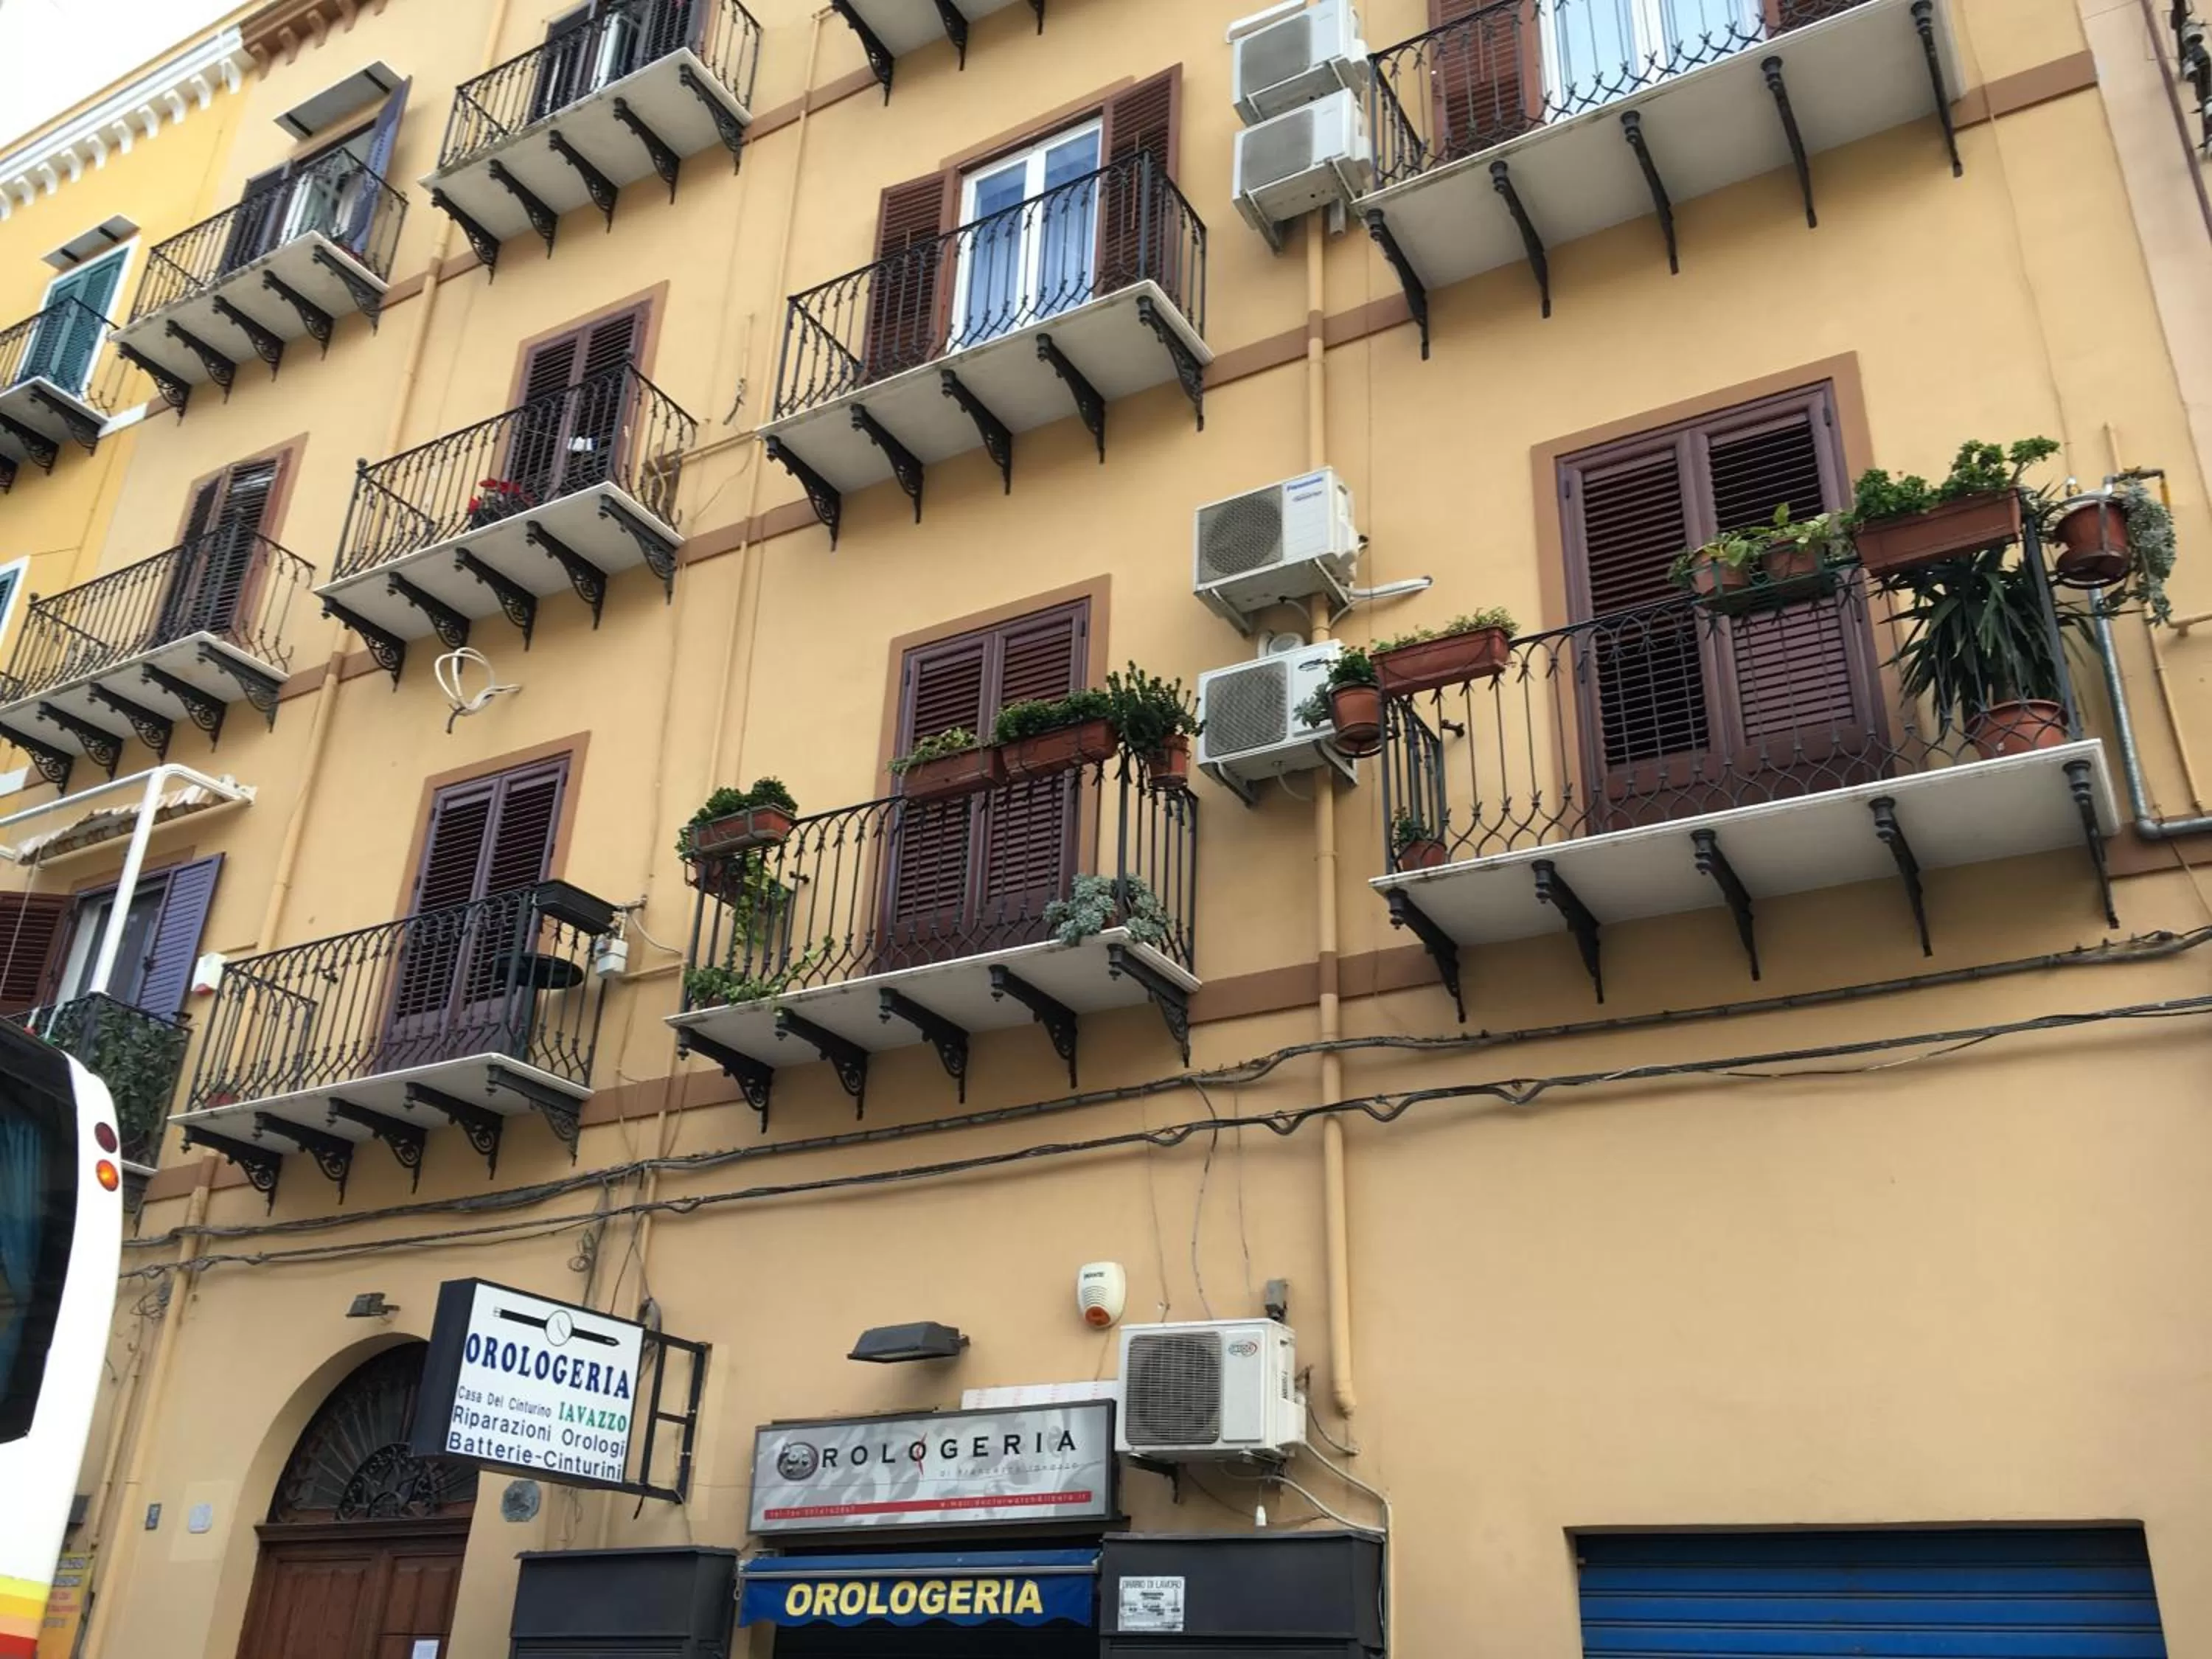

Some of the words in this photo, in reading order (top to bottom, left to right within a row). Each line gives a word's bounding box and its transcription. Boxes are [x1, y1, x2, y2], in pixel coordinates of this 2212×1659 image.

[465, 1332, 630, 1399] OROLOGERIA
[452, 1405, 552, 1441] Riparazioni
[561, 1429, 626, 1458] Orologi
[458, 1385, 482, 1403] Casa
[508, 1397, 552, 1419] Cinturino
[558, 1401, 627, 1433] IAVAZZO
[448, 1431, 622, 1480] Batterie-Cinturini
[785, 1579, 1044, 1616] OROLOGERIA
